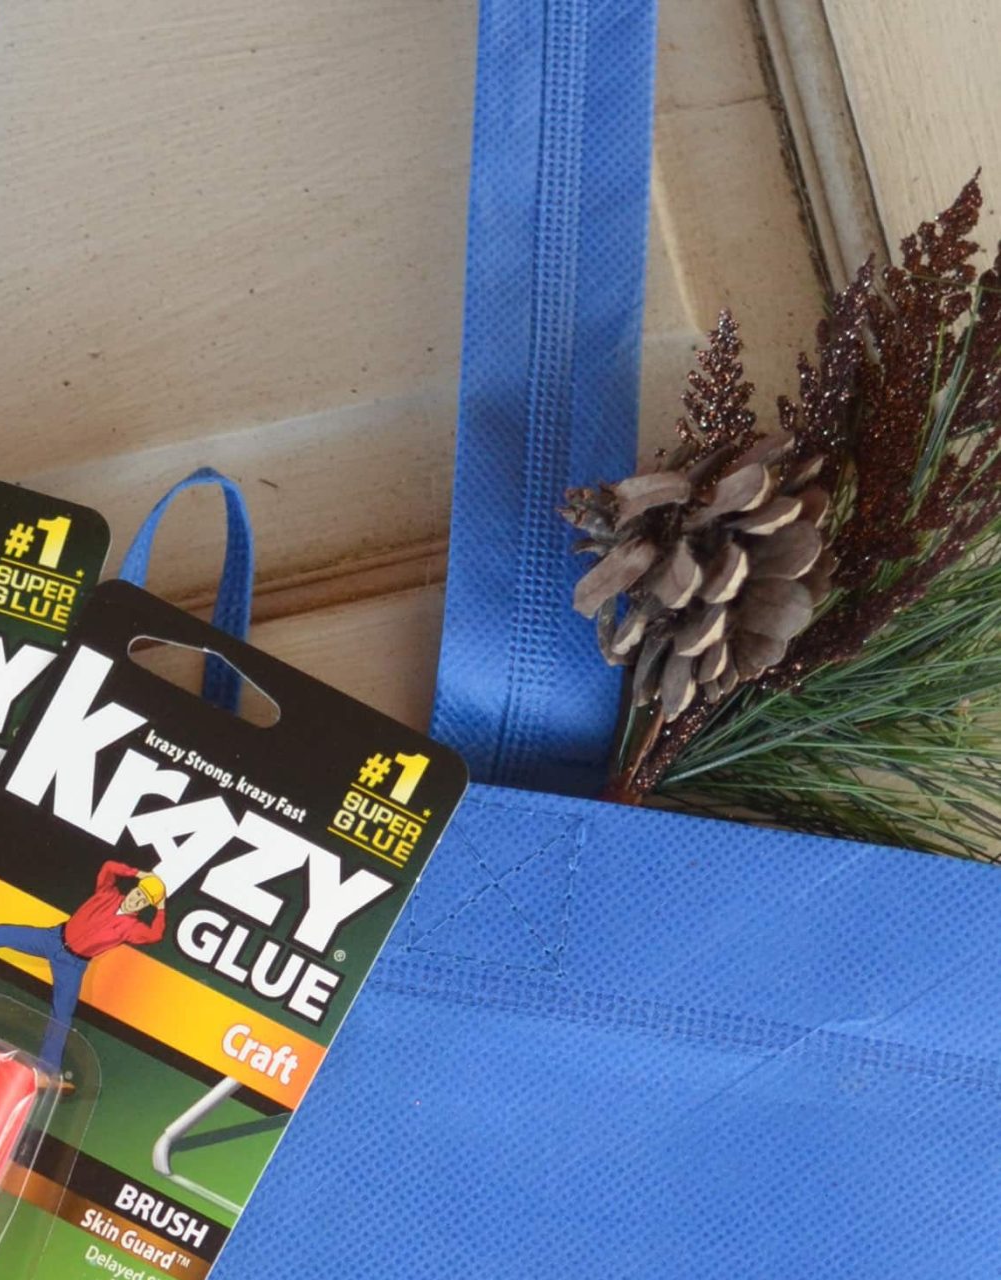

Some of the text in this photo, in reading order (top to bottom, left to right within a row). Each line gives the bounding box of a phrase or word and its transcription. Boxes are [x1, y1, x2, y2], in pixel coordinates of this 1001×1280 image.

[184, 750, 235, 788] Strong,
[275, 796, 307, 823] Fast
[343, 791, 422, 843] SUPER
[333, 809, 414, 862] GLUE
[177, 909, 340, 1022] GLUE
[222, 1024, 298, 1085] Craft
[80, 1209, 120, 1242] Skin
[114, 1184, 209, 1248] BRUSH
